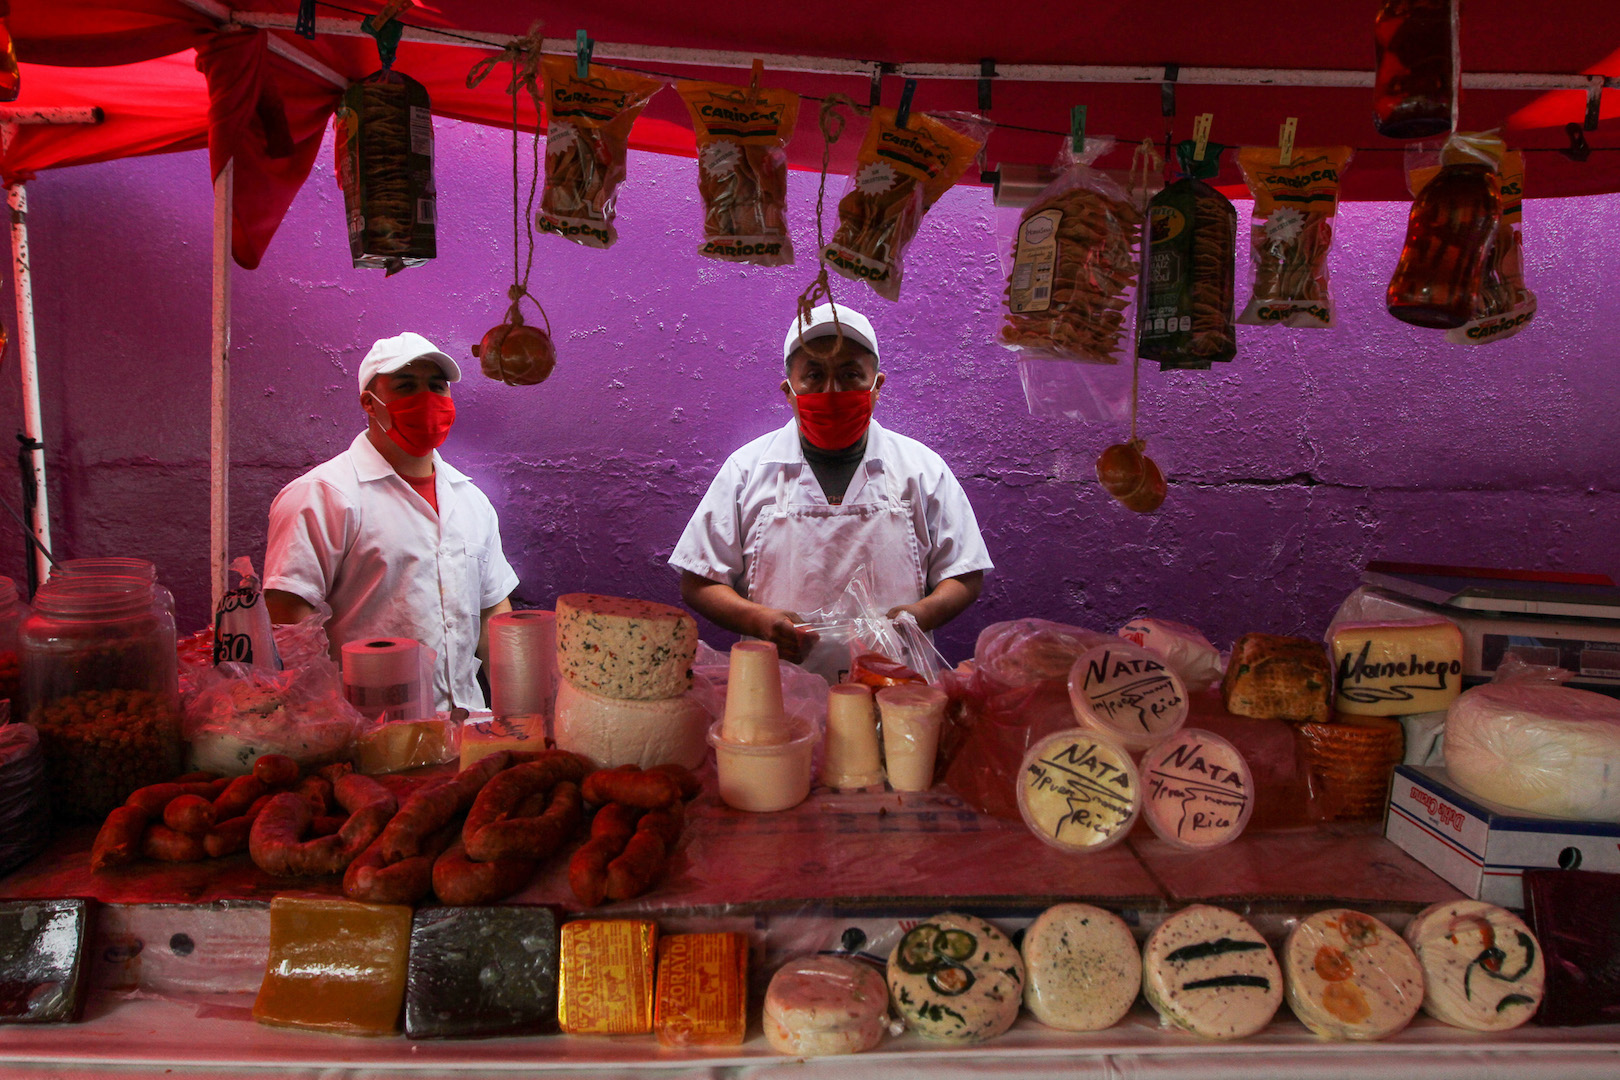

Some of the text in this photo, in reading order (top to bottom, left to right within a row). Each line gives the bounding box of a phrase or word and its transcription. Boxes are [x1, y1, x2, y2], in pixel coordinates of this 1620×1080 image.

[1083, 650, 1165, 690] NATA
[1052, 744, 1129, 788] NATA
[1160, 744, 1245, 788] NATA
